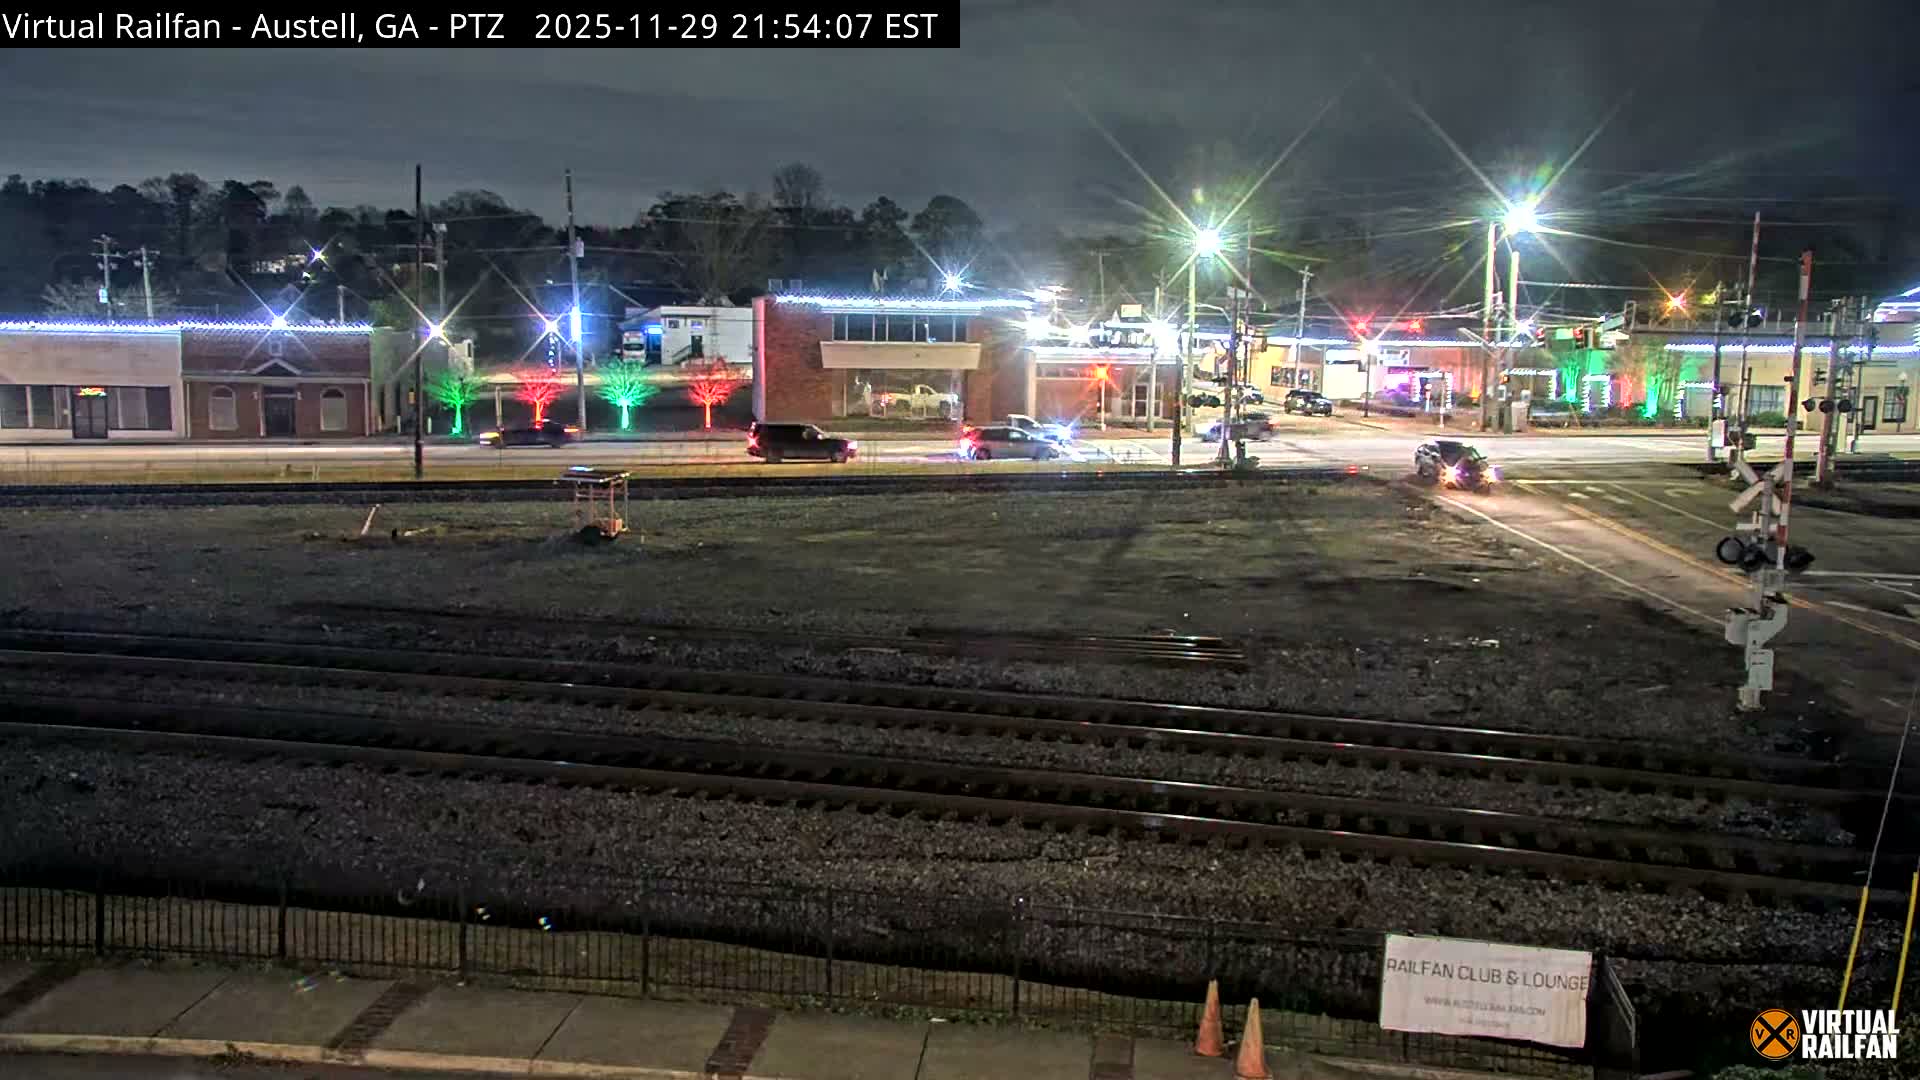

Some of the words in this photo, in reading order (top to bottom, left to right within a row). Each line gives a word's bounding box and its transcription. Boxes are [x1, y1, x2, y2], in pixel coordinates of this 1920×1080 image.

[1386, 957, 1454, 980] RAILFAN
[1457, 964, 1502, 984] CLUB
[1505, 969, 1520, 986] &
[1522, 971, 1589, 991] LOUNGE
